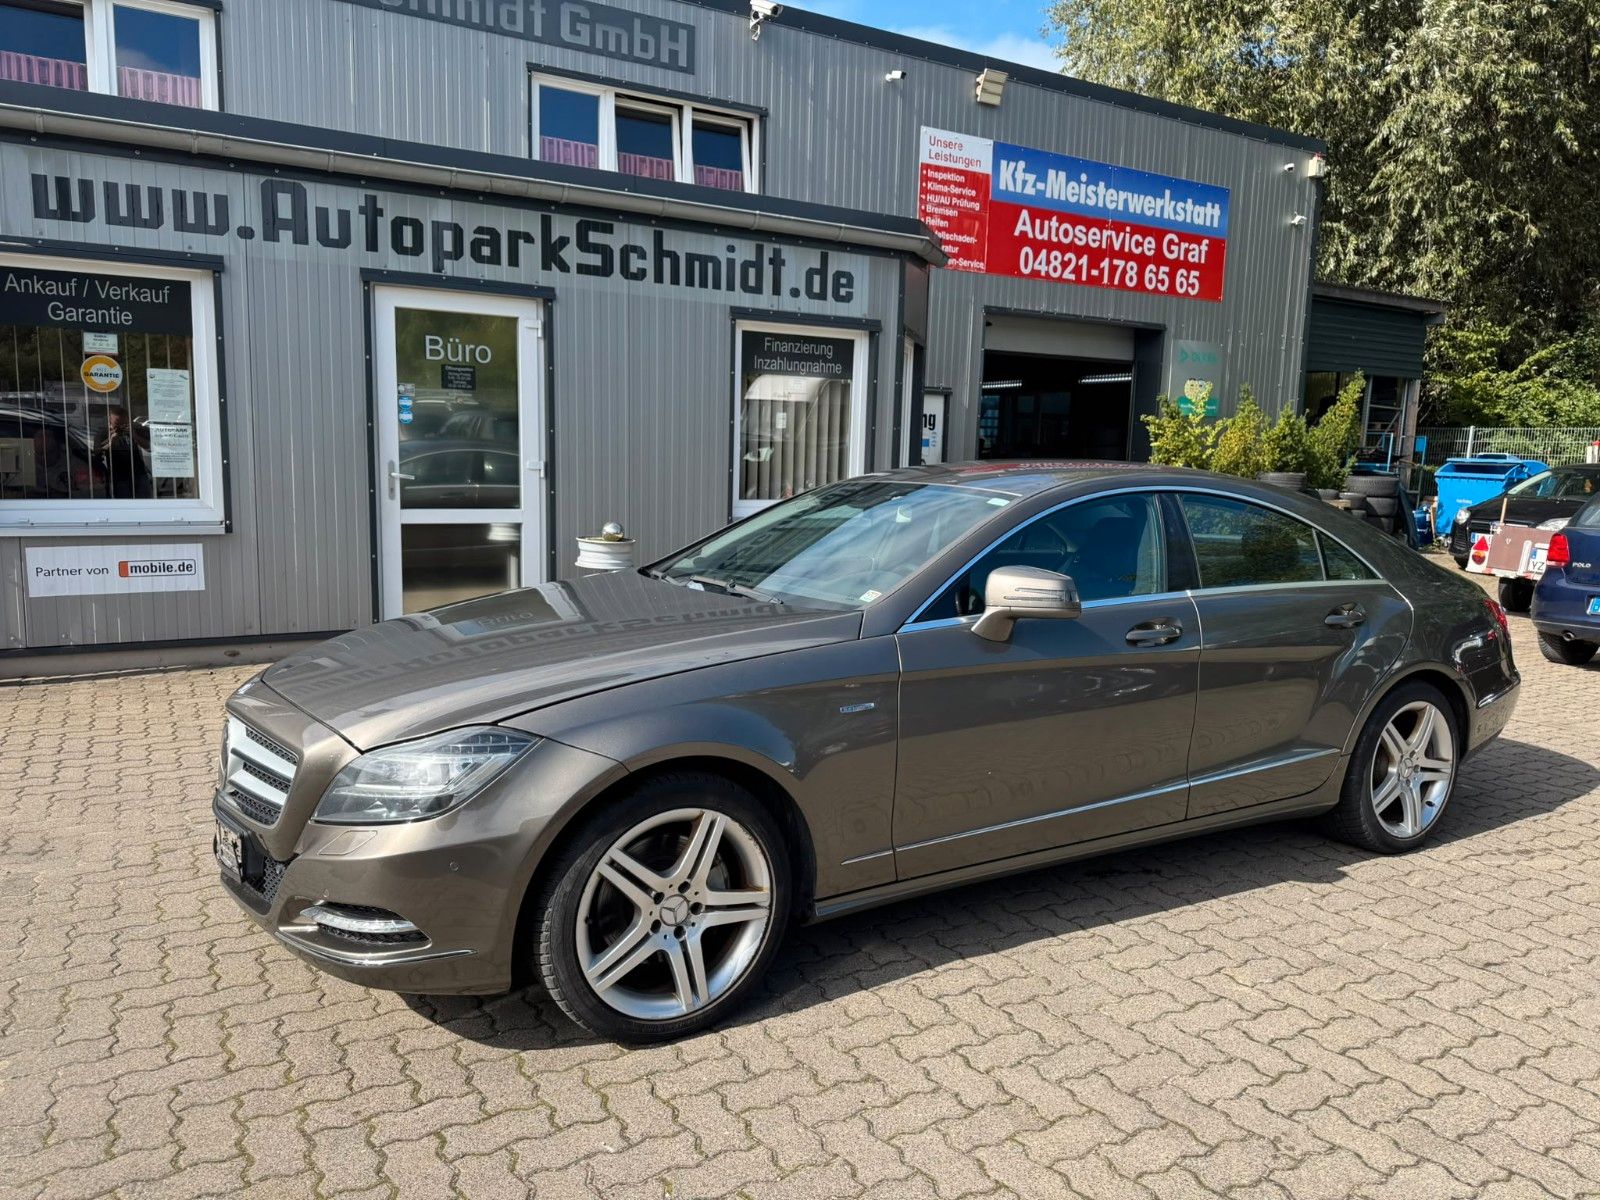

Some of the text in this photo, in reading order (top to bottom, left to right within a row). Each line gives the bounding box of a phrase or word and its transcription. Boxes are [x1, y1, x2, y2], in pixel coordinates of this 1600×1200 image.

[560, 2, 688, 67] GmbH
[929, 135, 964, 151] Unsere
[928, 149, 982, 168] Leistungen
[927, 168, 965, 183] Inspektion
[927, 181, 977, 197] Klima-Service
[999, 159, 1221, 228] Kfz-Meisterwerkstatt
[926, 193, 980, 211] HU/AU Prüfung
[926, 204, 959, 217] Bremsen
[926, 216, 949, 228] Reifen
[31, 173, 855, 304] www.AutoparkSchmidt.de
[1014, 209, 1209, 264] Autoservice Graf
[1020, 246, 1200, 296] 04821-178 65 65
[4, 273, 78, 297] Ankauf
[95, 279, 170, 304] Verkauf
[47, 302, 133, 325] Garantie
[425, 334, 492, 364] Büro
[764, 337, 834, 358] Finanzierung
[754, 356, 842, 375] Inzahlungnahme
[36, 562, 193, 577] Partner von mobile.de
